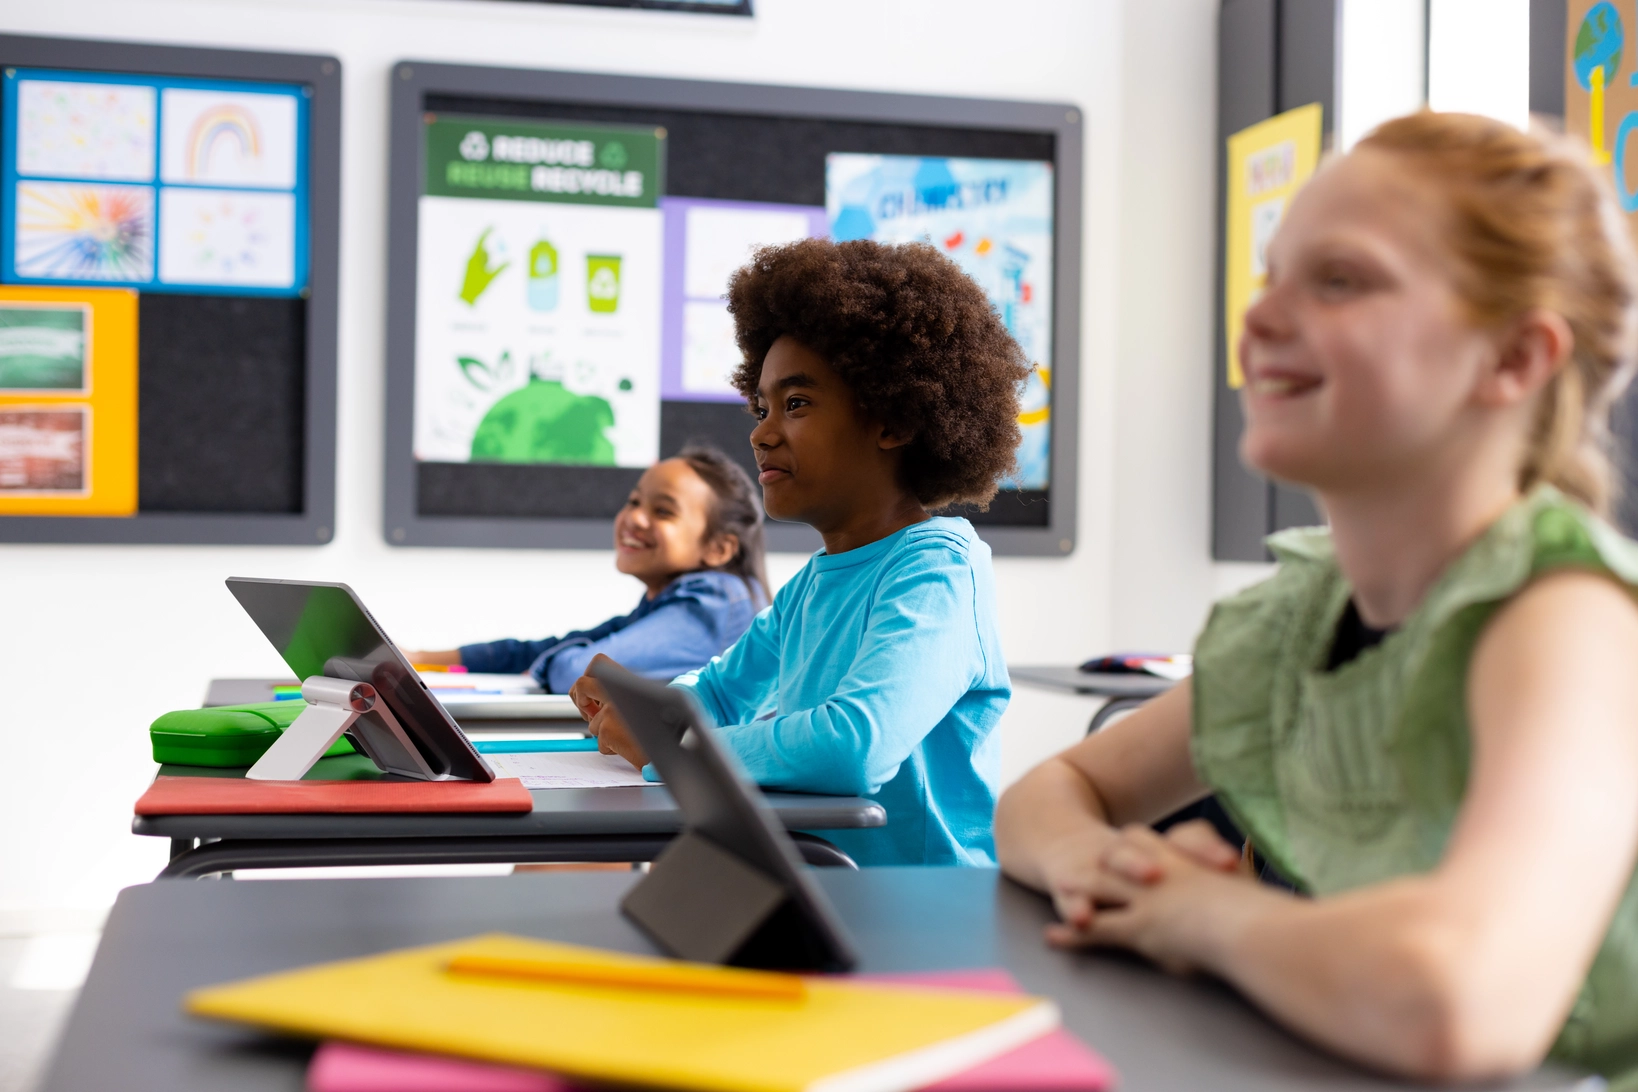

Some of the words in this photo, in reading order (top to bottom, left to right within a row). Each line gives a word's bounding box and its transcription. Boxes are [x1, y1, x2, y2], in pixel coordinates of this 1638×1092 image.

[492, 135, 595, 167] REDUCE
[447, 161, 529, 191] REUSE
[531, 165, 643, 197] RECYCLE
